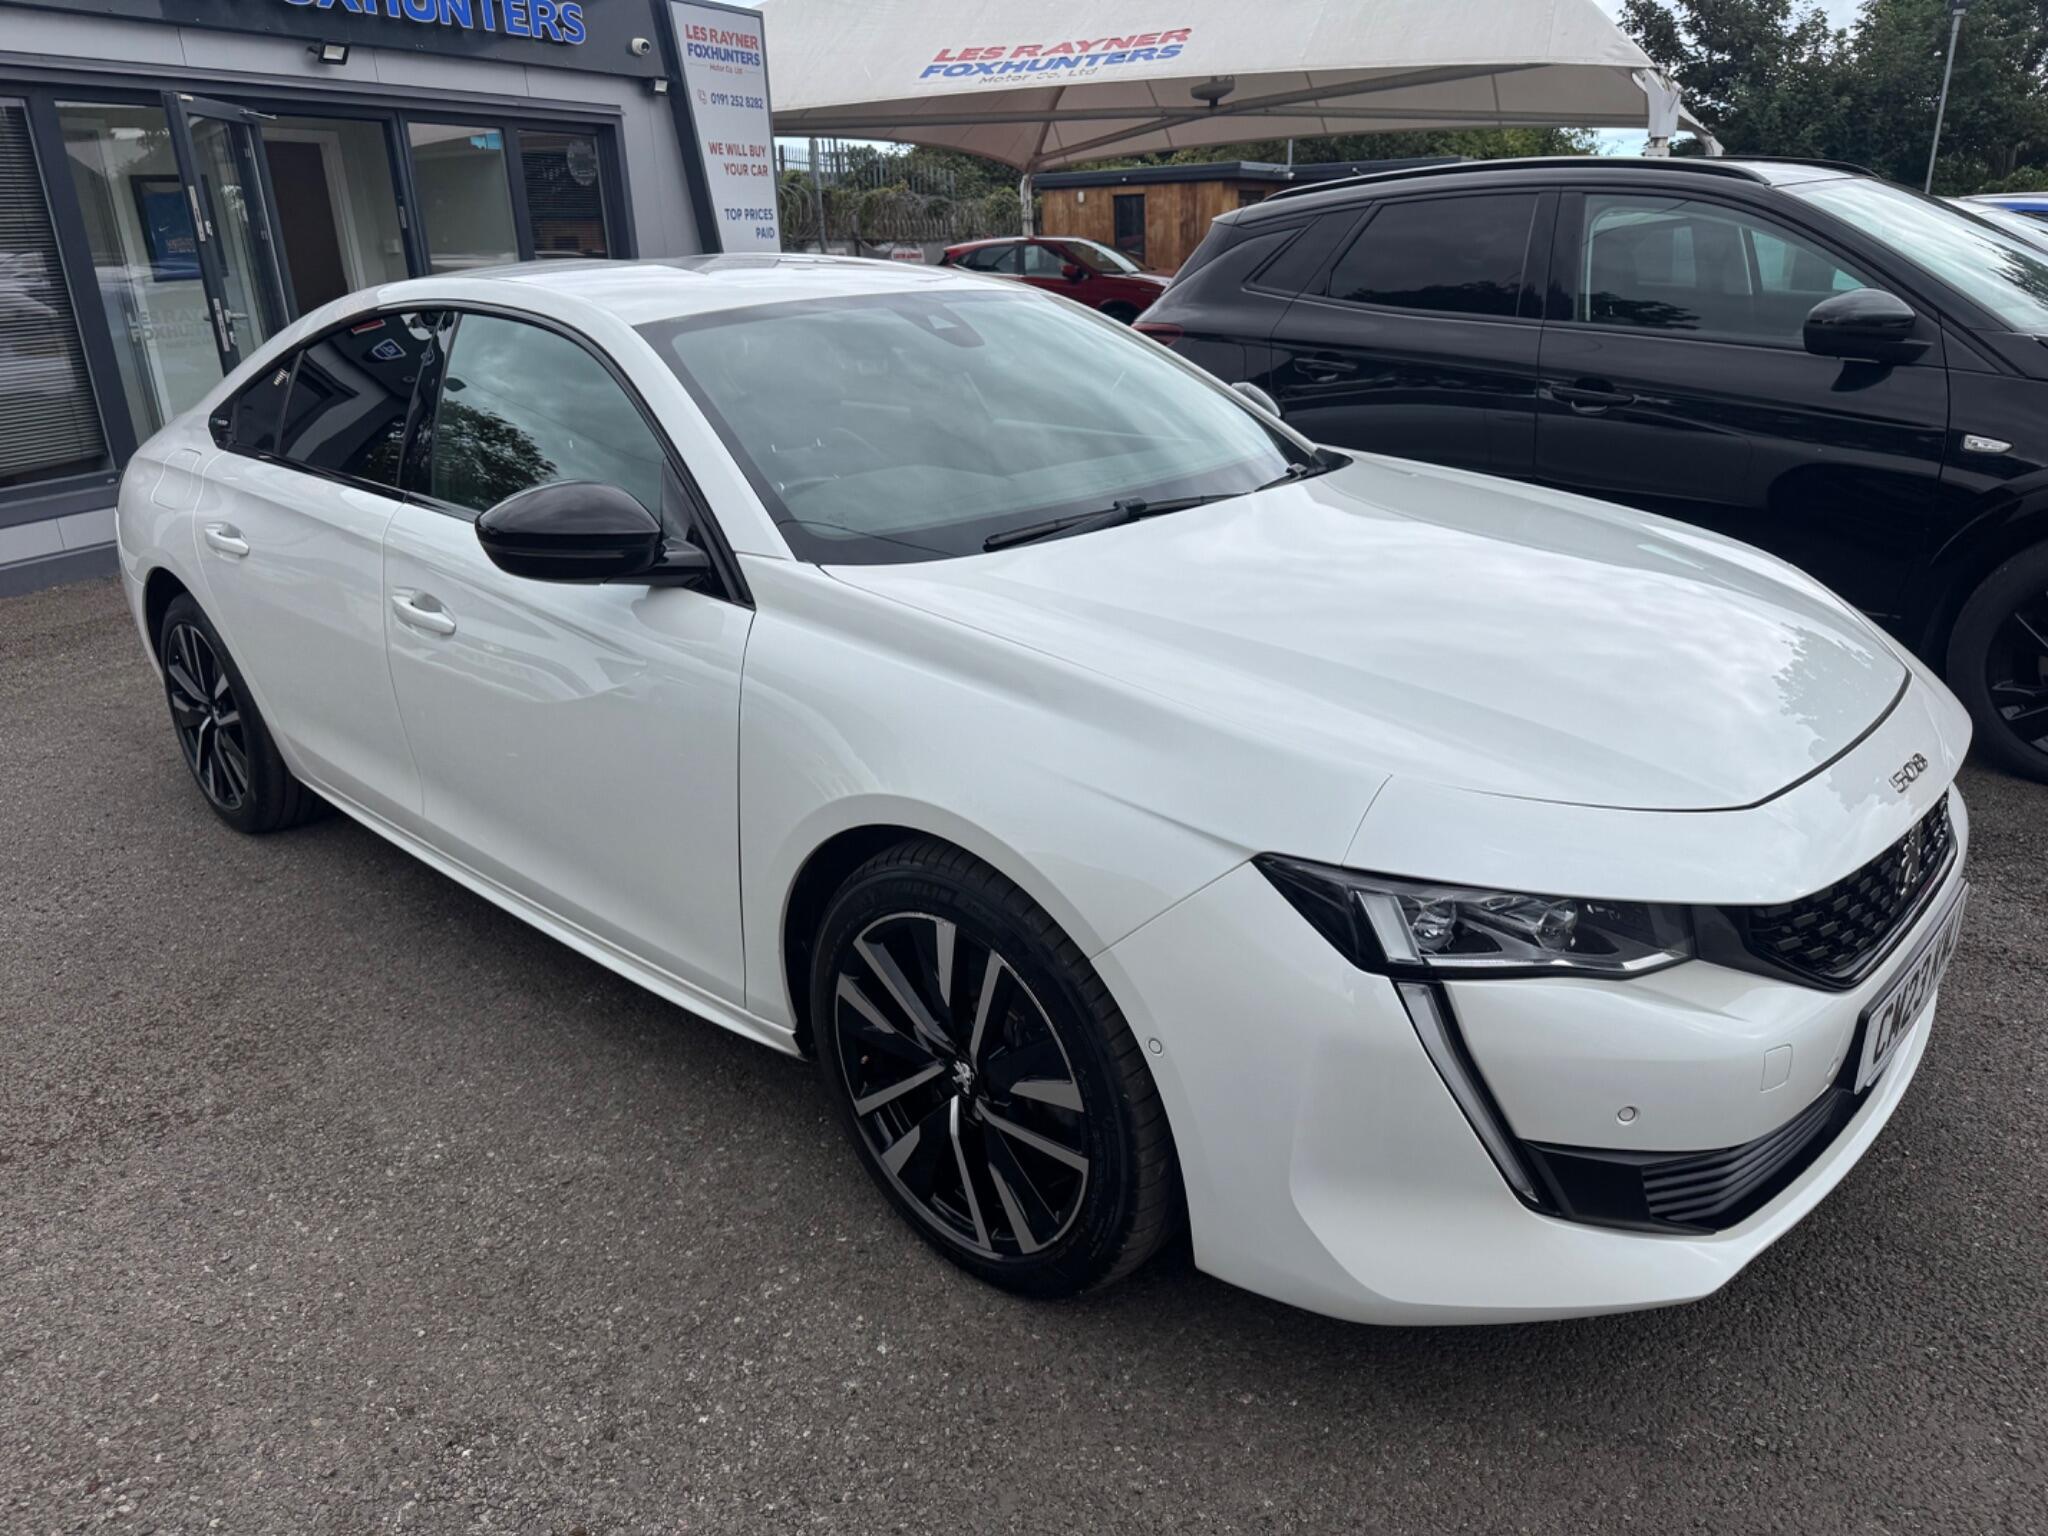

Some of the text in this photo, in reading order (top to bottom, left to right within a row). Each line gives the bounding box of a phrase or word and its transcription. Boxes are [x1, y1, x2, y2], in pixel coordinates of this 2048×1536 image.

[685, 24, 758, 50] LES RAYNER
[933, 28, 1193, 62] LES RAYNER
[687, 42, 760, 66] FOXHUNTERS
[919, 44, 1184, 79] FOXHUNTERS
[711, 92, 763, 109] 0191 252 8282
[709, 143, 766, 157] WE WILL BUY
[724, 163, 768, 176] YOUR CAR
[724, 208, 773, 220] TOP PRICES
[756, 227, 775, 240] PAID
[1889, 753, 1928, 793] 508
